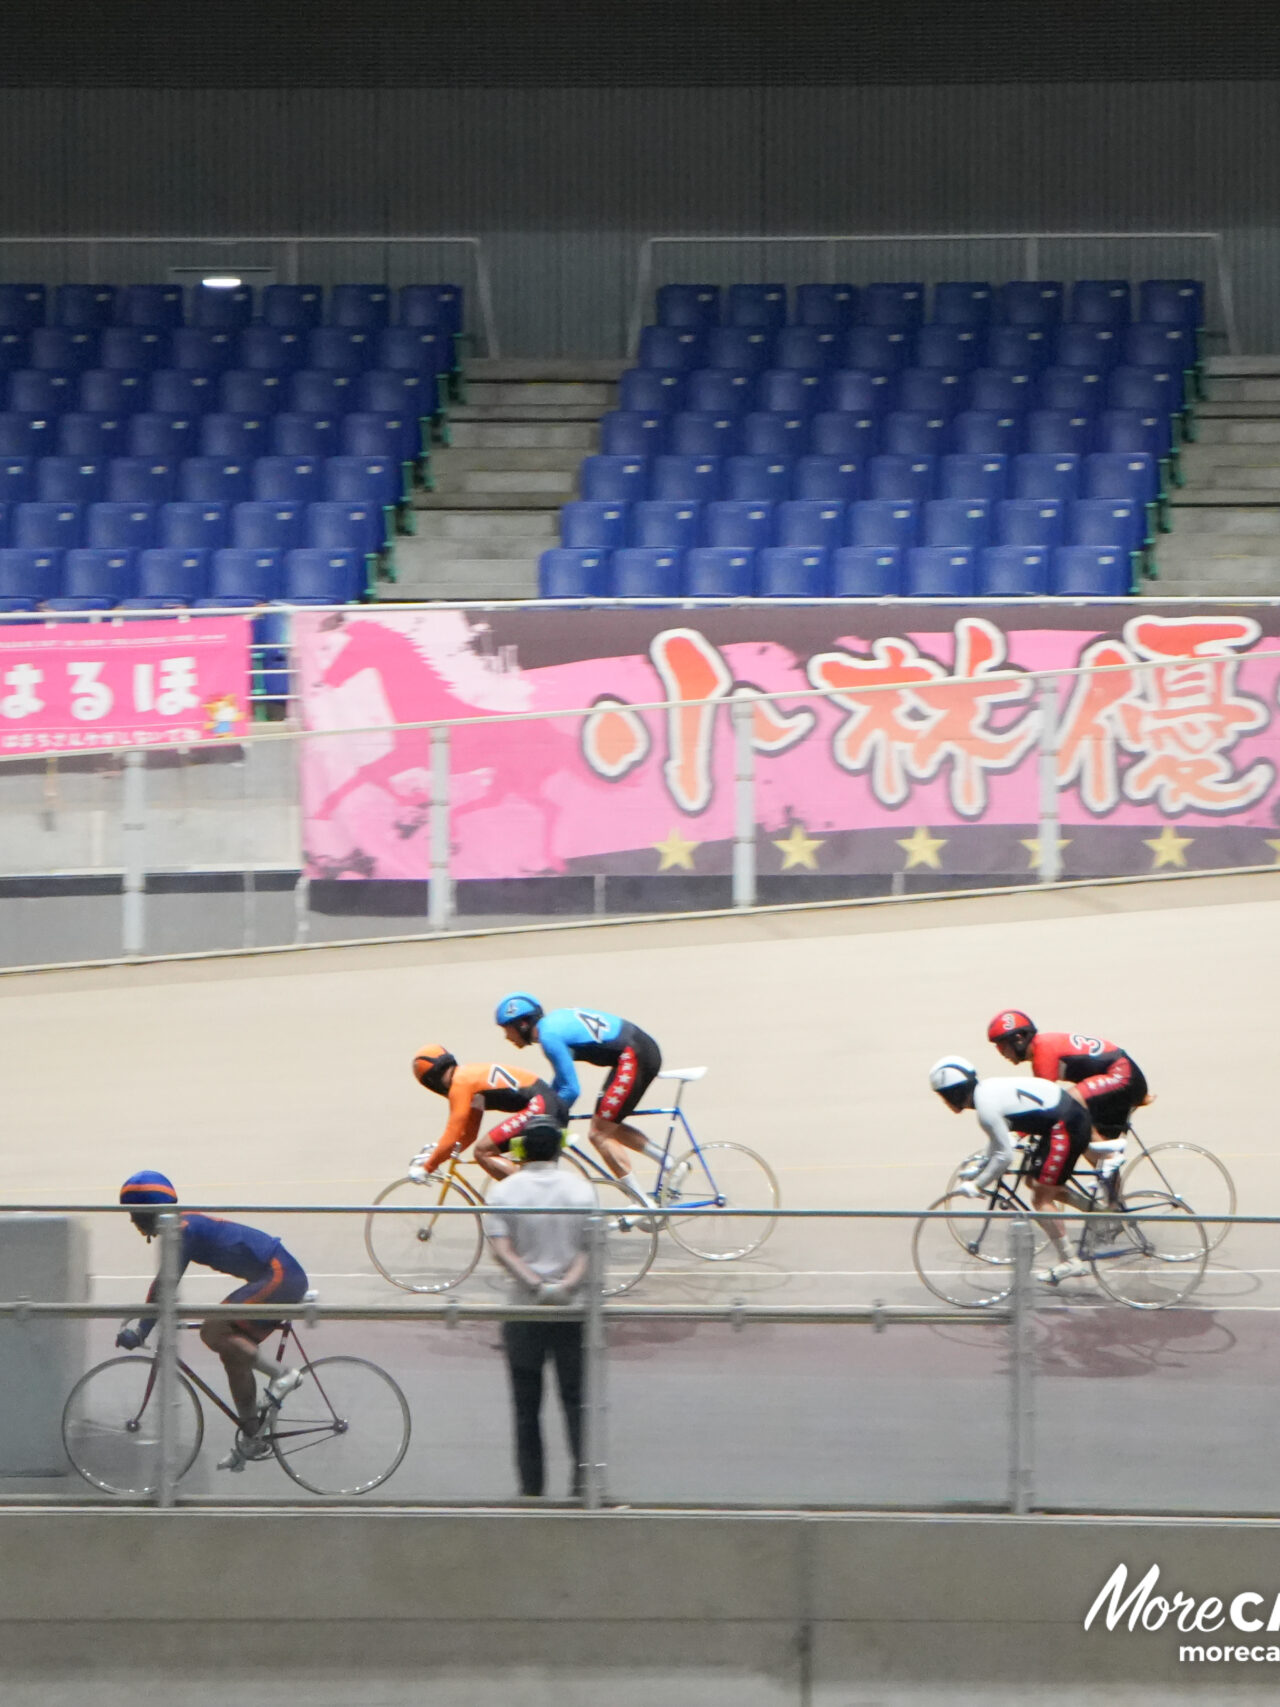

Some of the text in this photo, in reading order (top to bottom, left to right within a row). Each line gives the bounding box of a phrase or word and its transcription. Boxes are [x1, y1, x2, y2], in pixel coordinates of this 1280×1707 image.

[575, 1009, 612, 1043] 4
[1002, 1013, 1016, 1030] 3
[1070, 1033, 1104, 1057] 3
[488, 1064, 521, 1092] 7
